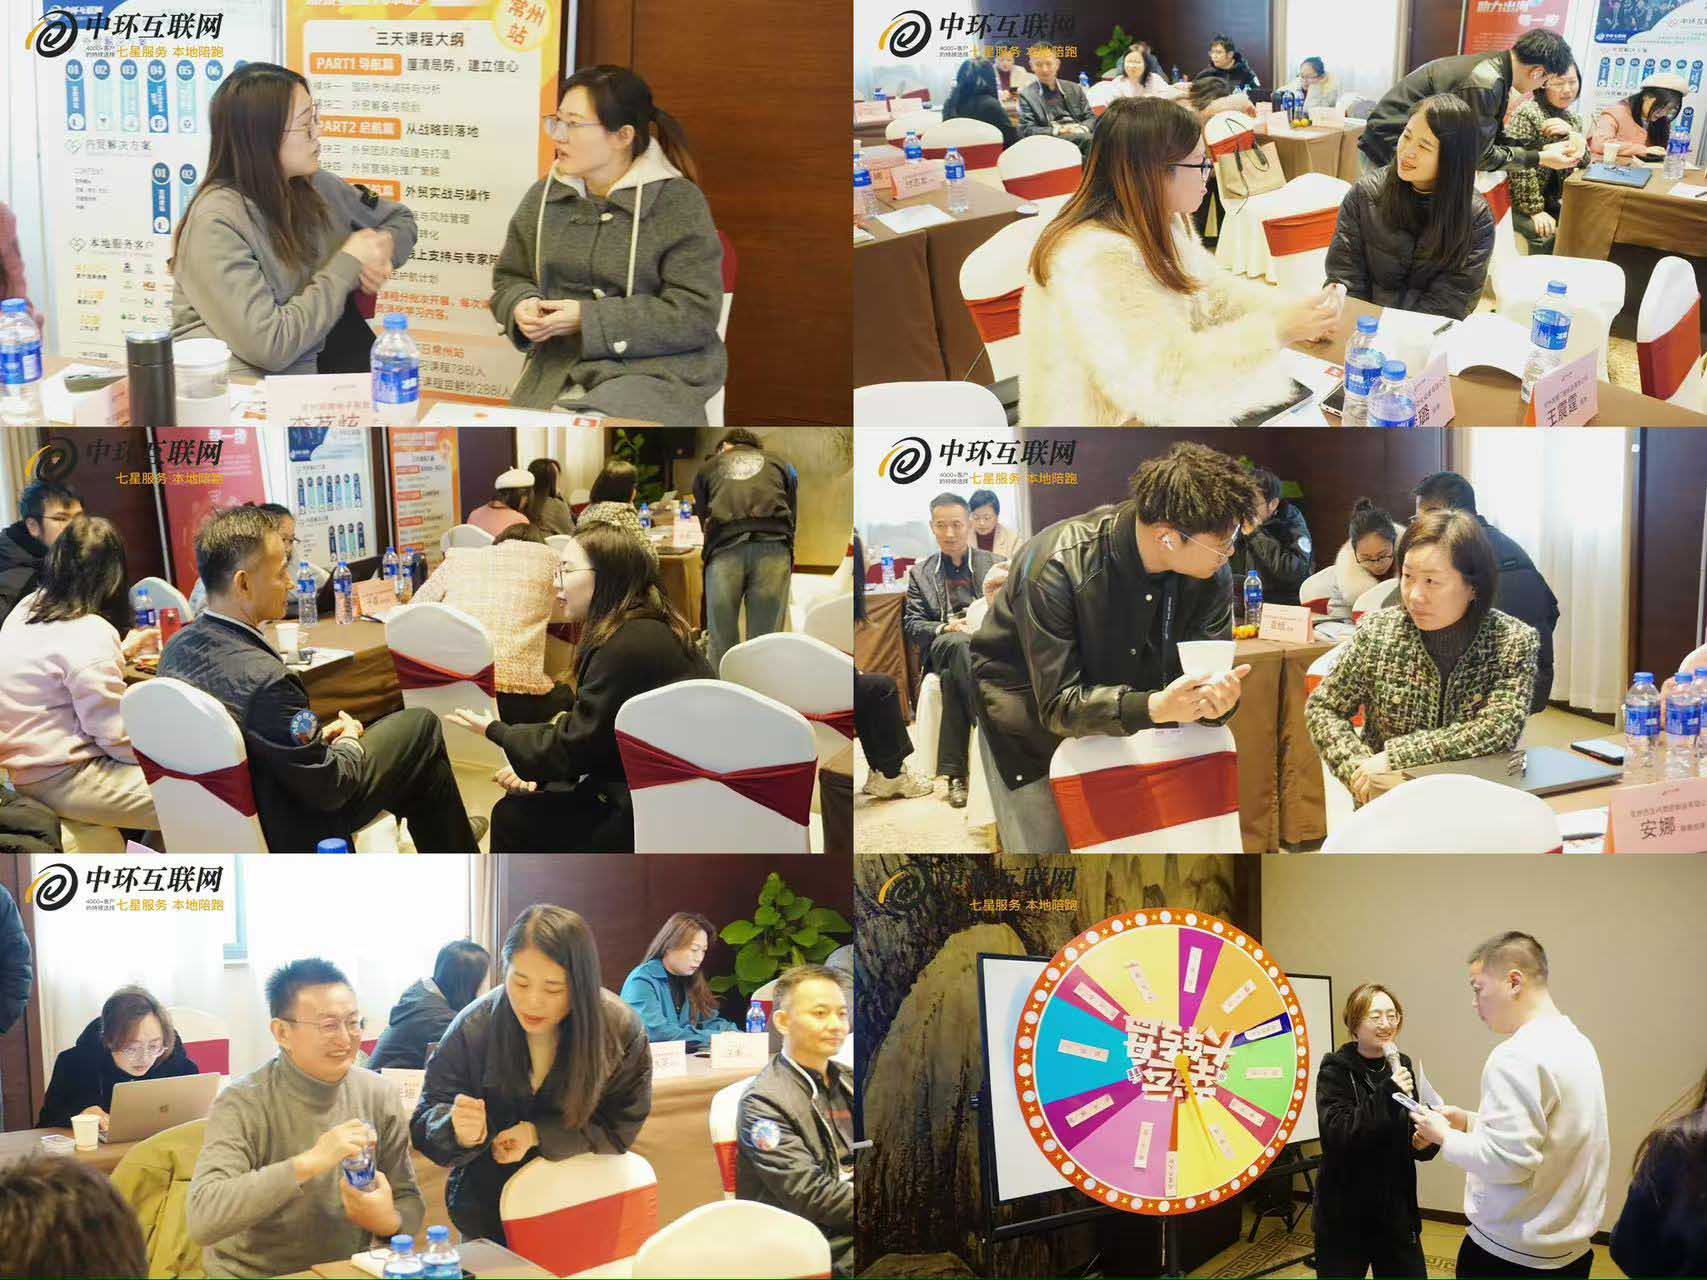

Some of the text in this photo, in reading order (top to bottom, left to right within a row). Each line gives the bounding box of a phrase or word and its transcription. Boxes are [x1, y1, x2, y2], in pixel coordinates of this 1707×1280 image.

[376, 31, 465, 47] 三天课程大纲
[506, 25, 529, 46] 站
[67, 65, 81, 75] 01
[316, 57, 355, 71] PART1
[317, 121, 355, 134] PART2
[406, 123, 480, 138] 从战略到落地
[154, 168, 168, 178] 01
[405, 186, 491, 202] 外贸实战与操作
[1640, 816, 1676, 840] 安娜
